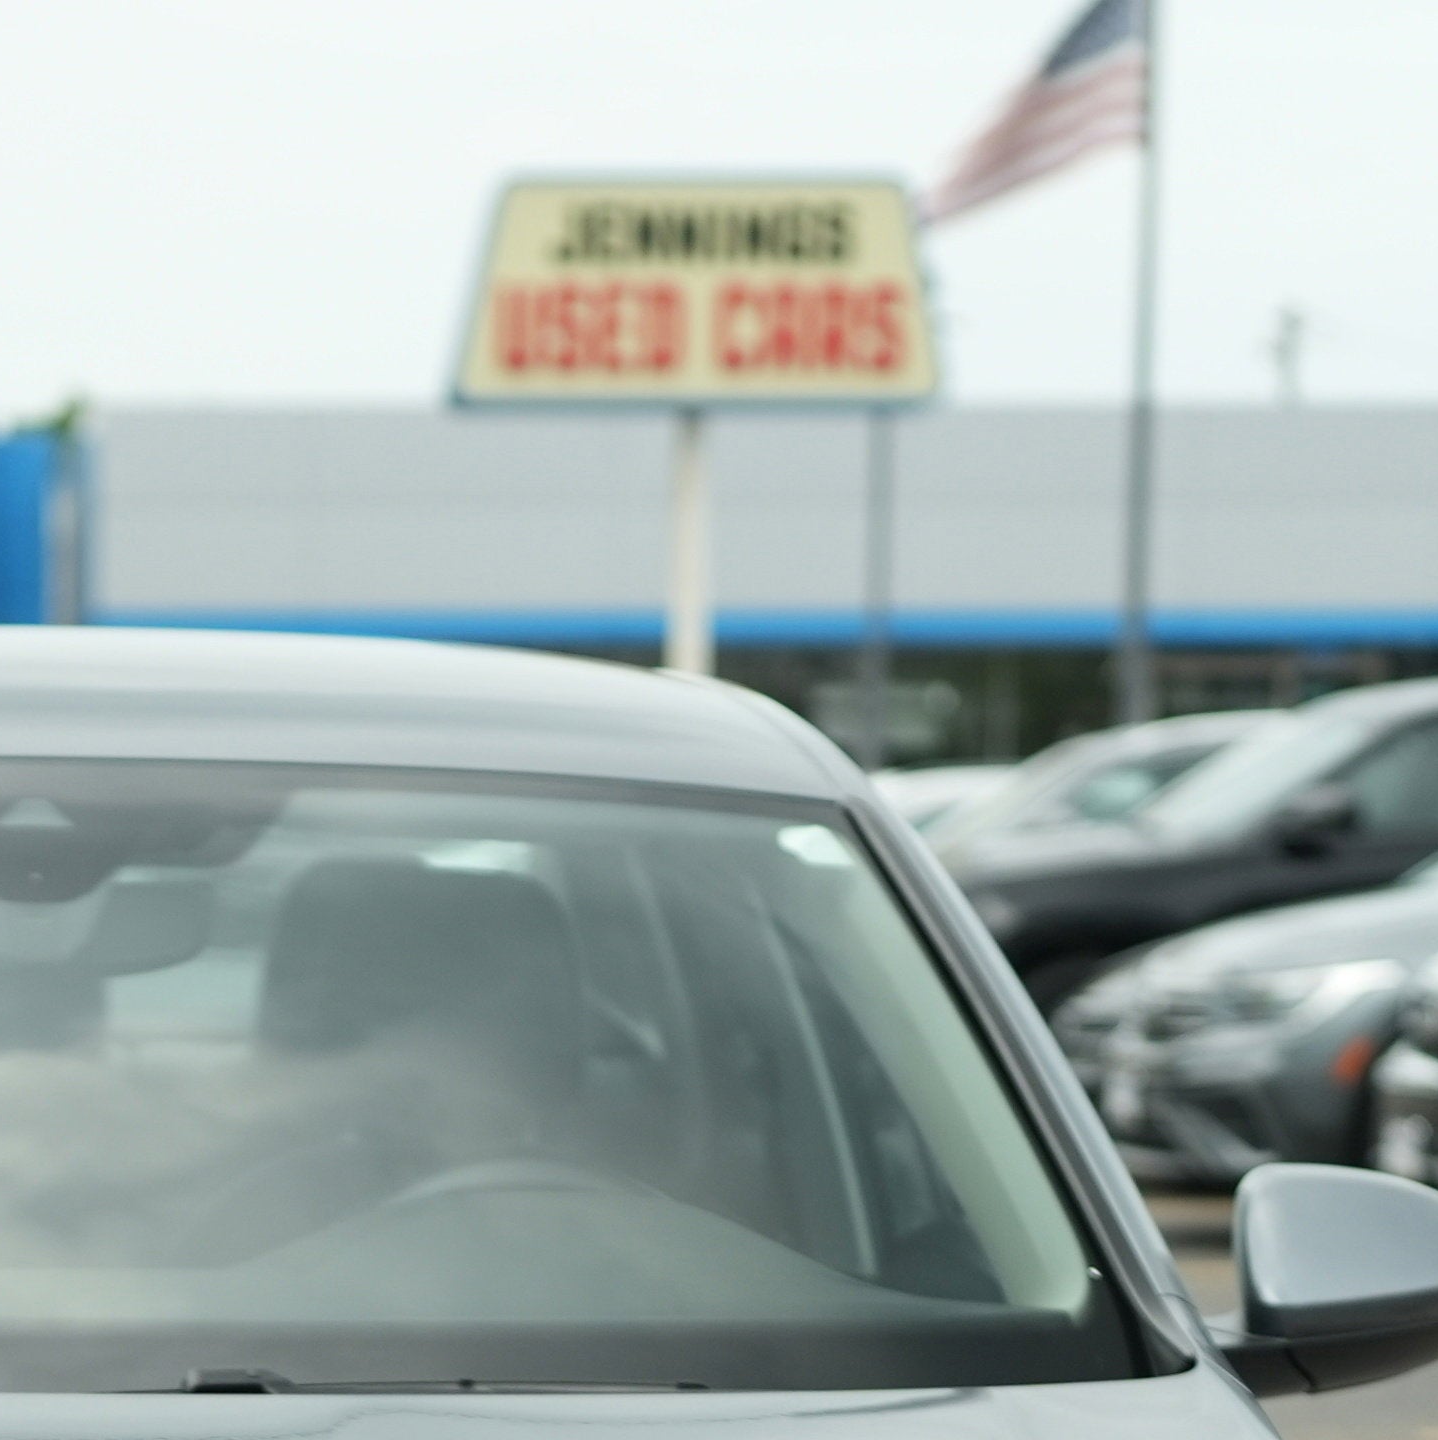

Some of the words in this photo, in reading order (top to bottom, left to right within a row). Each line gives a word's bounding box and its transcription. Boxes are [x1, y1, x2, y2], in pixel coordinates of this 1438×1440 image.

[546, 199, 852, 263] JENNINGS
[497, 281, 683, 373] USED
[714, 279, 908, 373] CARS
